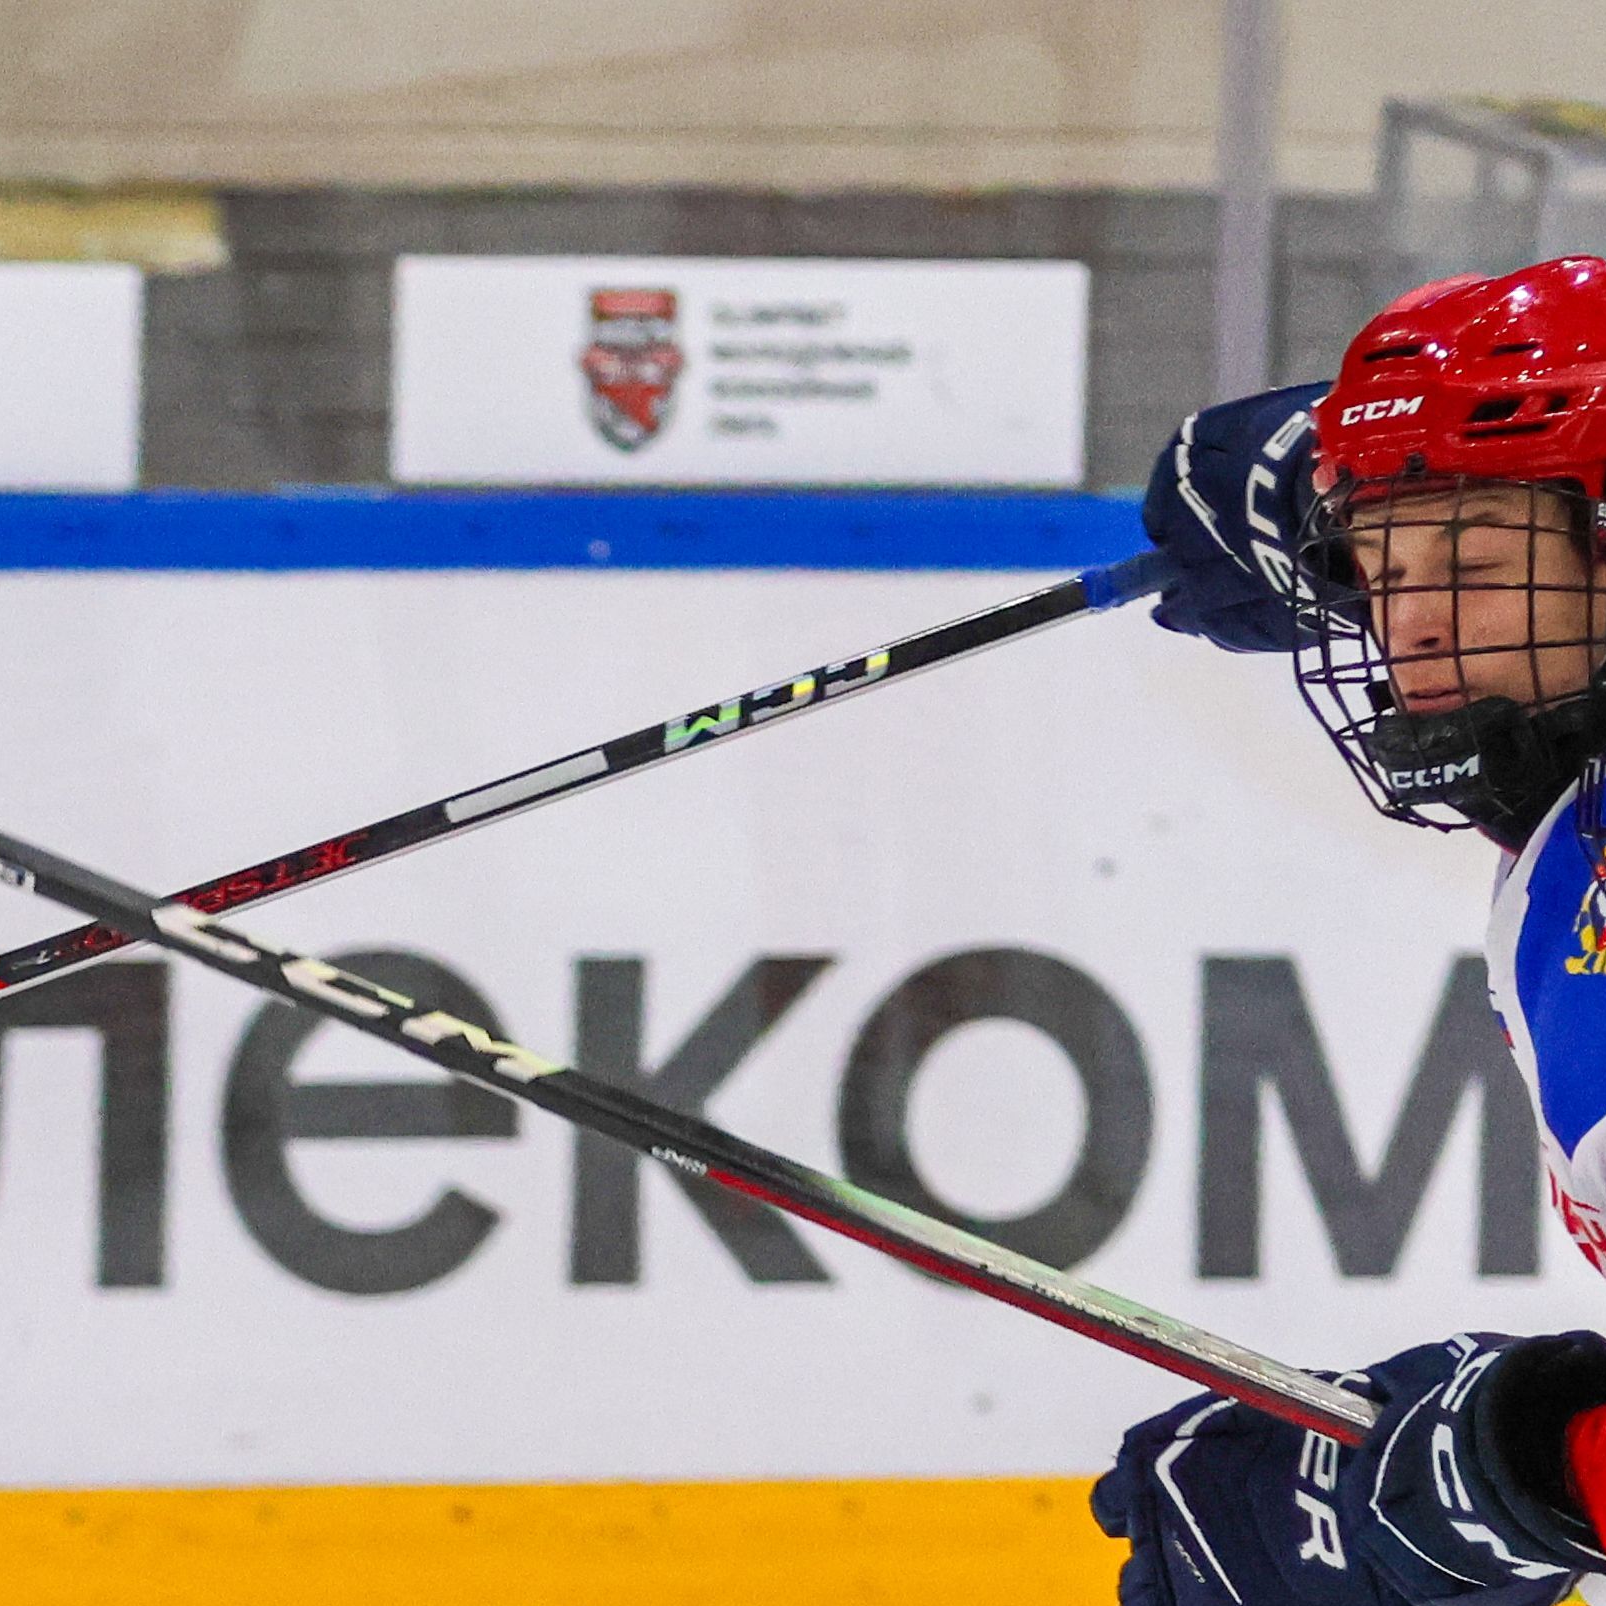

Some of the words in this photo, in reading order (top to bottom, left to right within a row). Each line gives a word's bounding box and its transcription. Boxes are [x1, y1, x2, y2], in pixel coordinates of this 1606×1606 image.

[1341, 395, 1425, 427] CCM
[1389, 754, 1481, 788] CCM
[152, 904, 566, 1082] CCM
